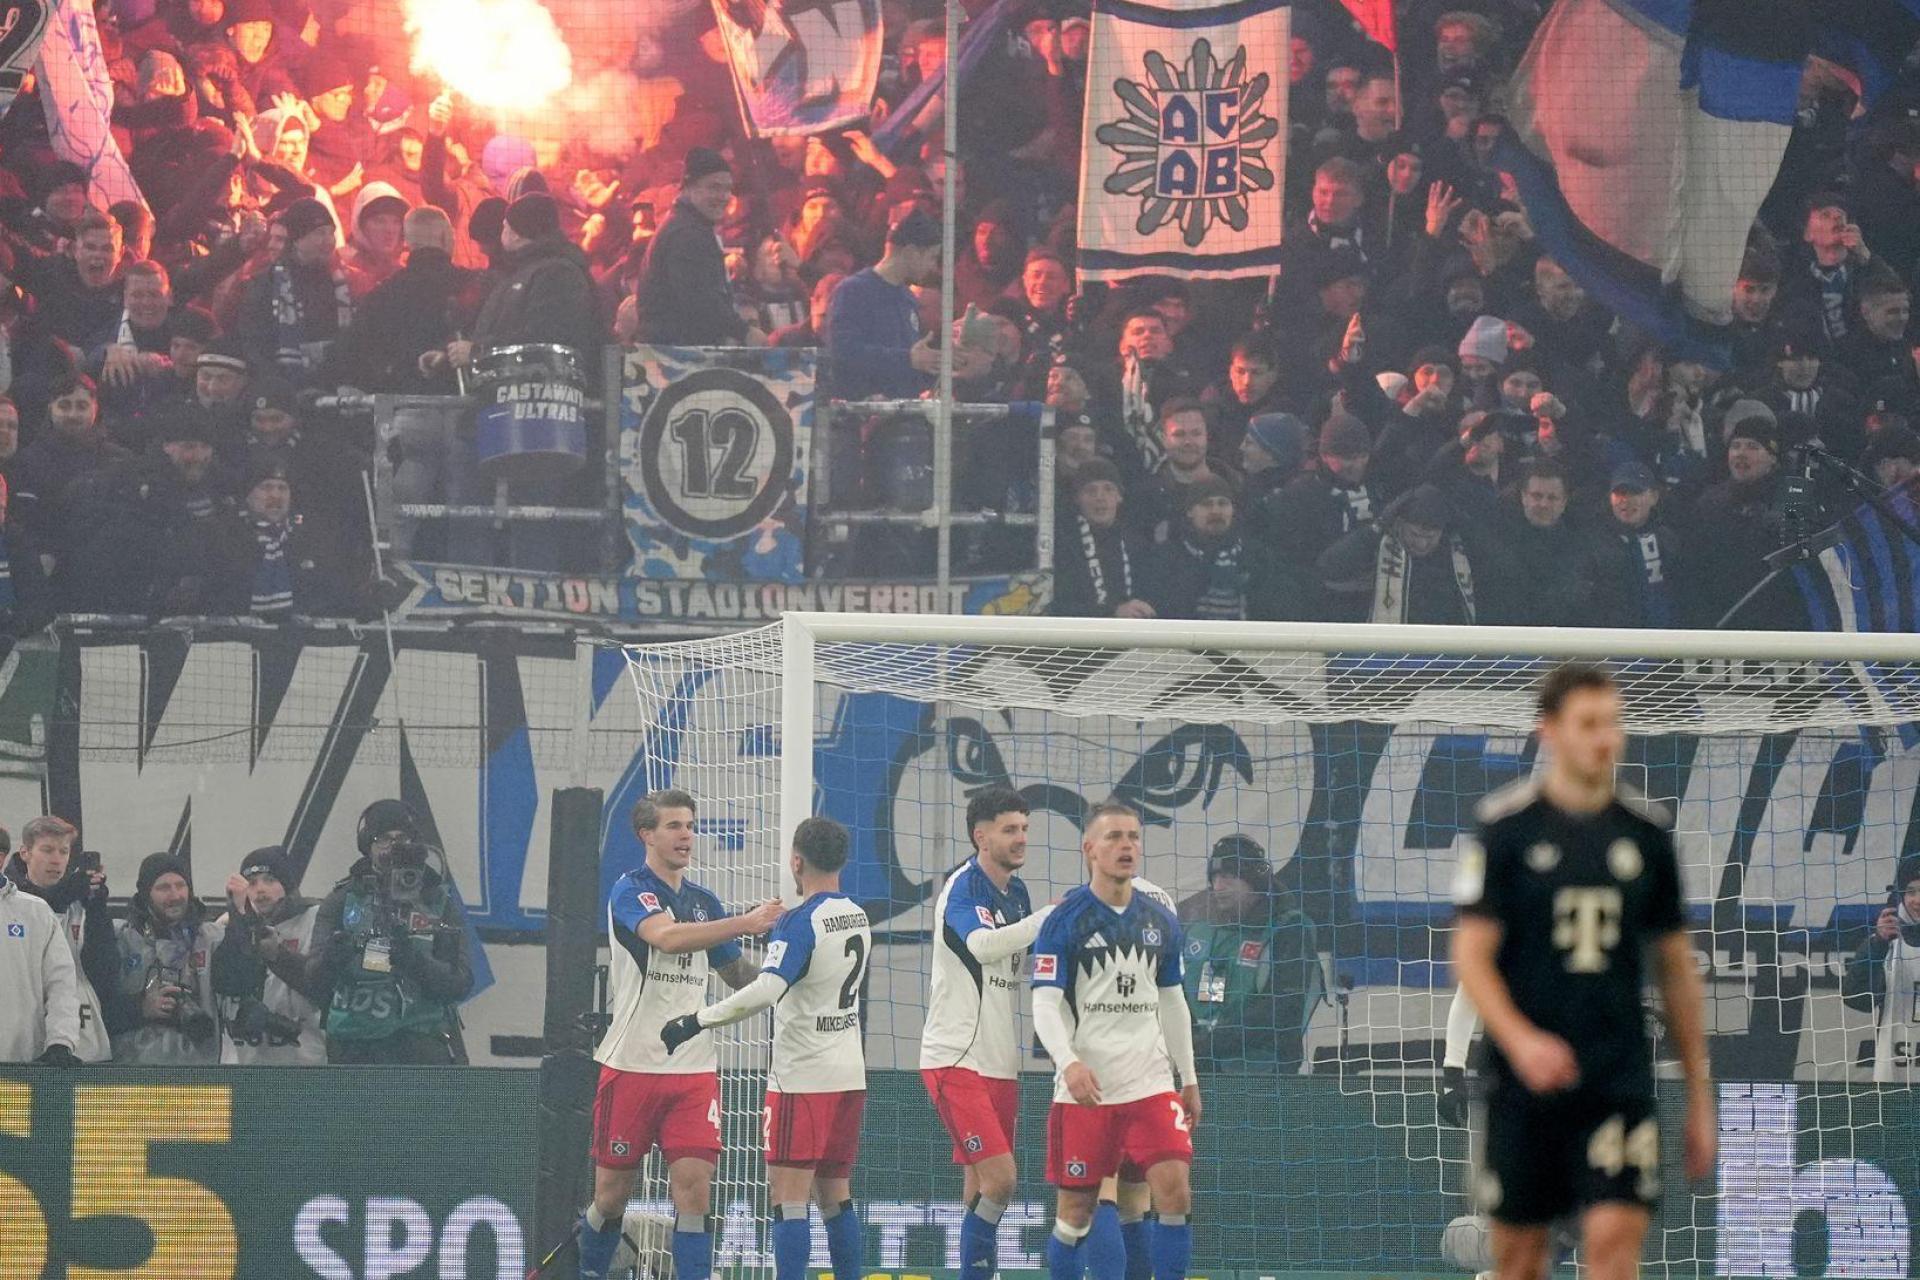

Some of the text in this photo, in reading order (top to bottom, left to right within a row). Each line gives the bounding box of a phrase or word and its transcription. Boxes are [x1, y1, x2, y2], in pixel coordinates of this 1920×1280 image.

[513, 401, 578, 423] ULTRAS
[670, 407, 760, 501] 12
[433, 568, 972, 620] SEKTION STADIONVERBOT
[1553, 886, 1623, 974] T
[838, 933, 865, 1010] 2
[1586, 1114, 1660, 1178] 44
